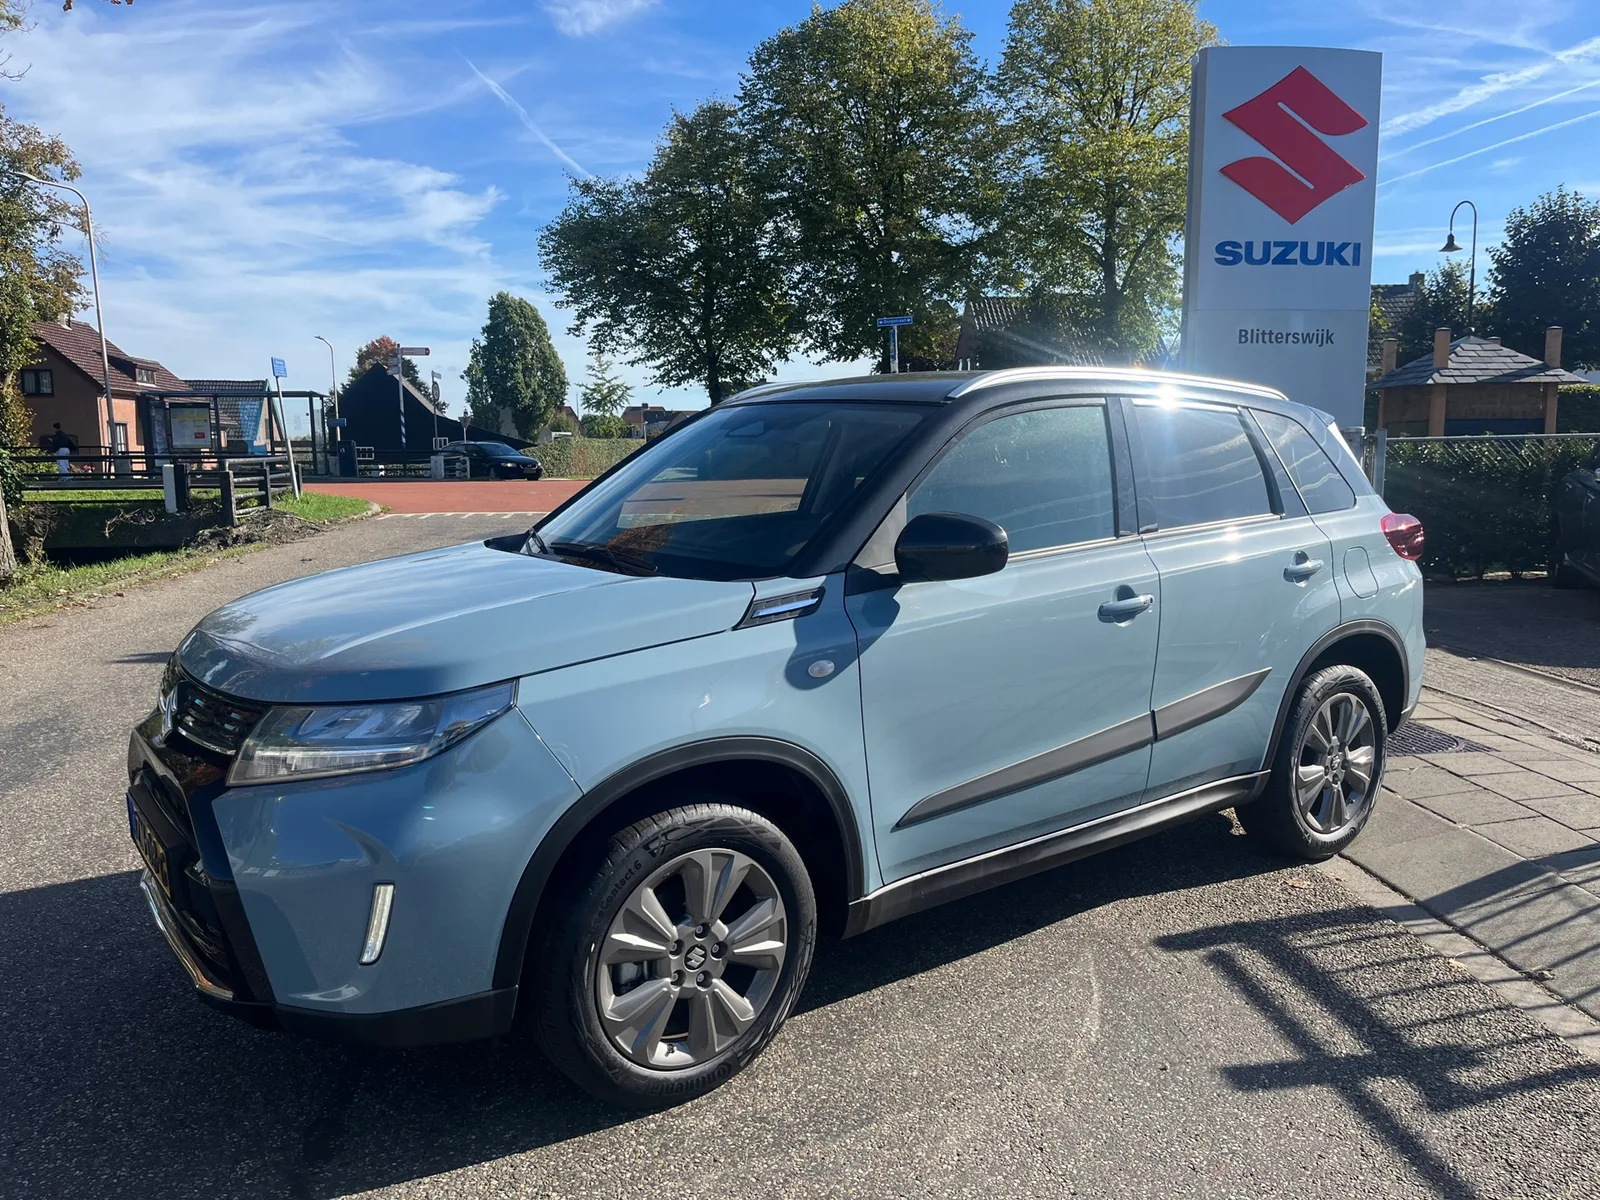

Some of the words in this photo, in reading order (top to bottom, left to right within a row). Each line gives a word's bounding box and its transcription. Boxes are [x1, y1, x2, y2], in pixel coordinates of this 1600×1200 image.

[1214, 240, 1362, 267] SUZUKI
[1238, 328, 1335, 347] Blitterswijk
[633, 859, 642, 870] 6
[643, 1061, 733, 1096] Continental
